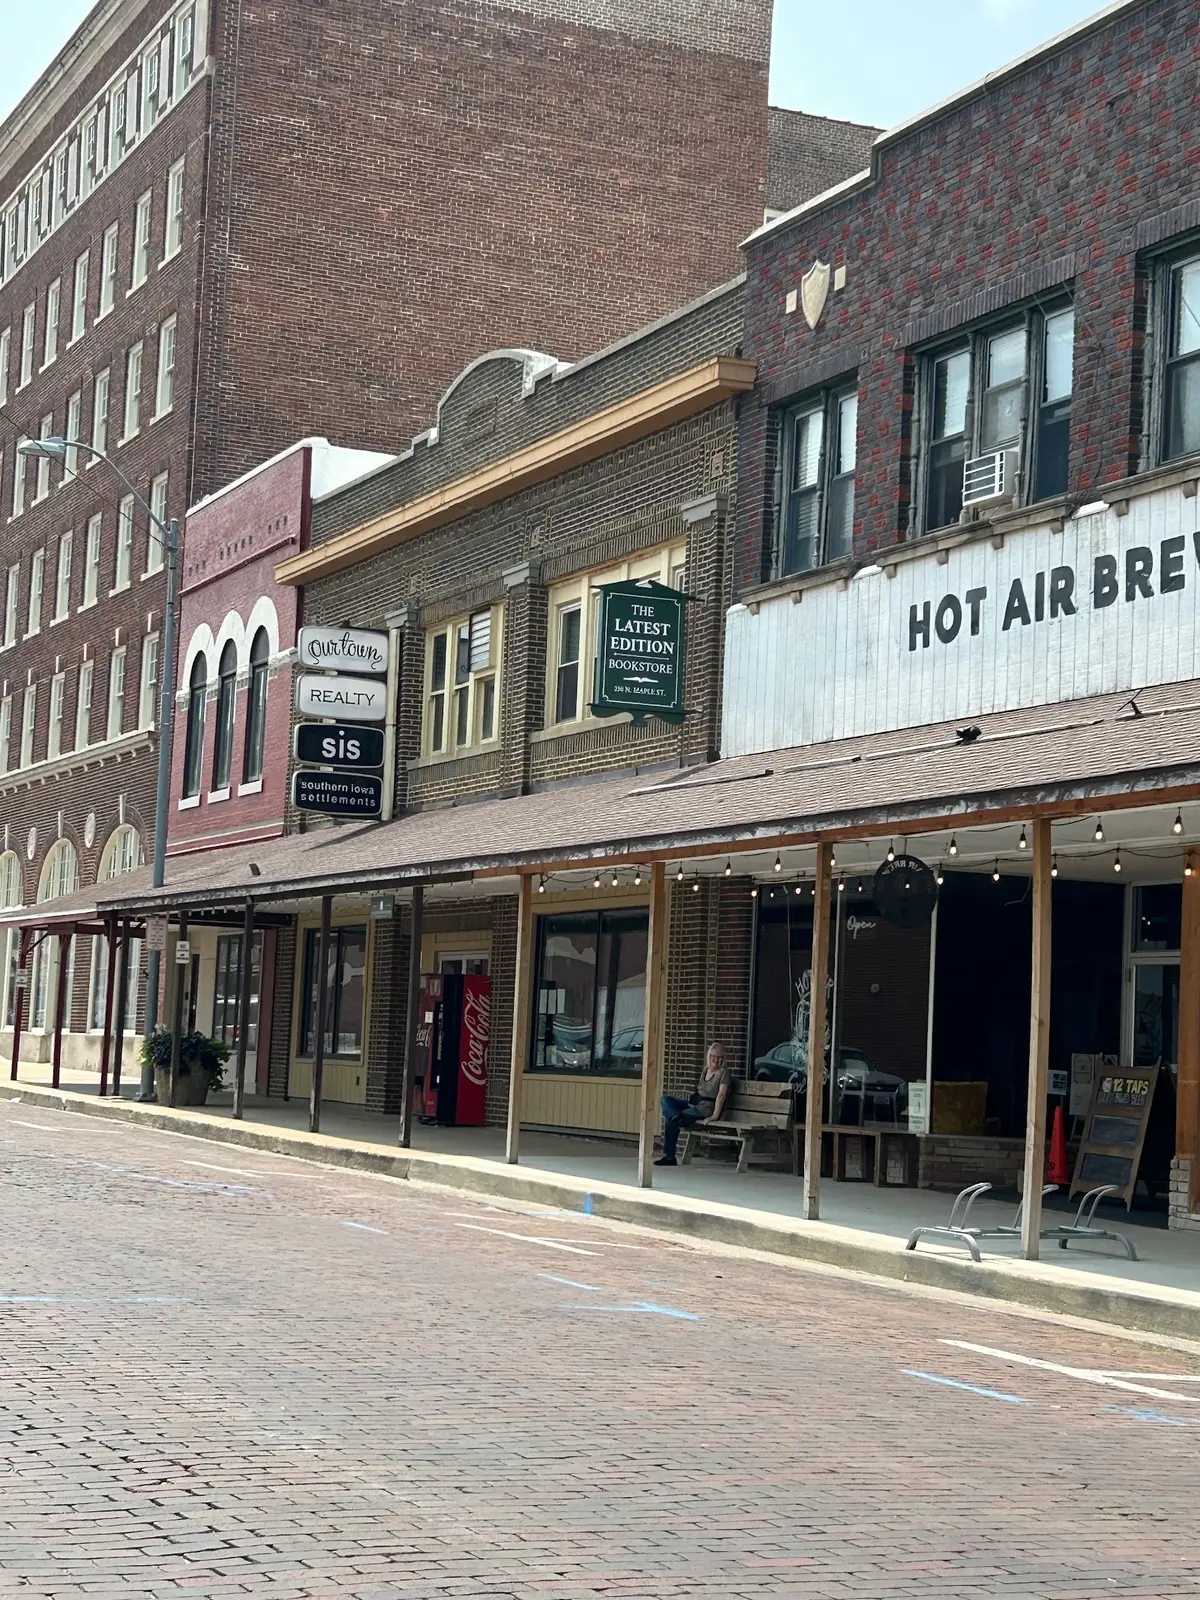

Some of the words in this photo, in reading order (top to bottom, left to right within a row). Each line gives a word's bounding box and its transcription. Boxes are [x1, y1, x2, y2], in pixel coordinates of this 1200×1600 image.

[631, 604, 655, 617] THE
[909, 586, 987, 652] HOT
[1002, 565, 1077, 632] AIR
[615, 618, 671, 636] LATEST
[610, 636, 675, 654] EDITION
[608, 659, 673, 674] BOOKSTORE
[310, 688, 376, 706] REALTY
[633, 687, 655, 695] MAPLE
[301, 780, 349, 793] southern
[350, 783, 375, 796] iowa
[301, 792, 376, 807] settlements
[846, 915, 877, 940] Open
[1112, 1078, 1124, 1092] 12
[1126, 1079, 1149, 1096] TAPS
